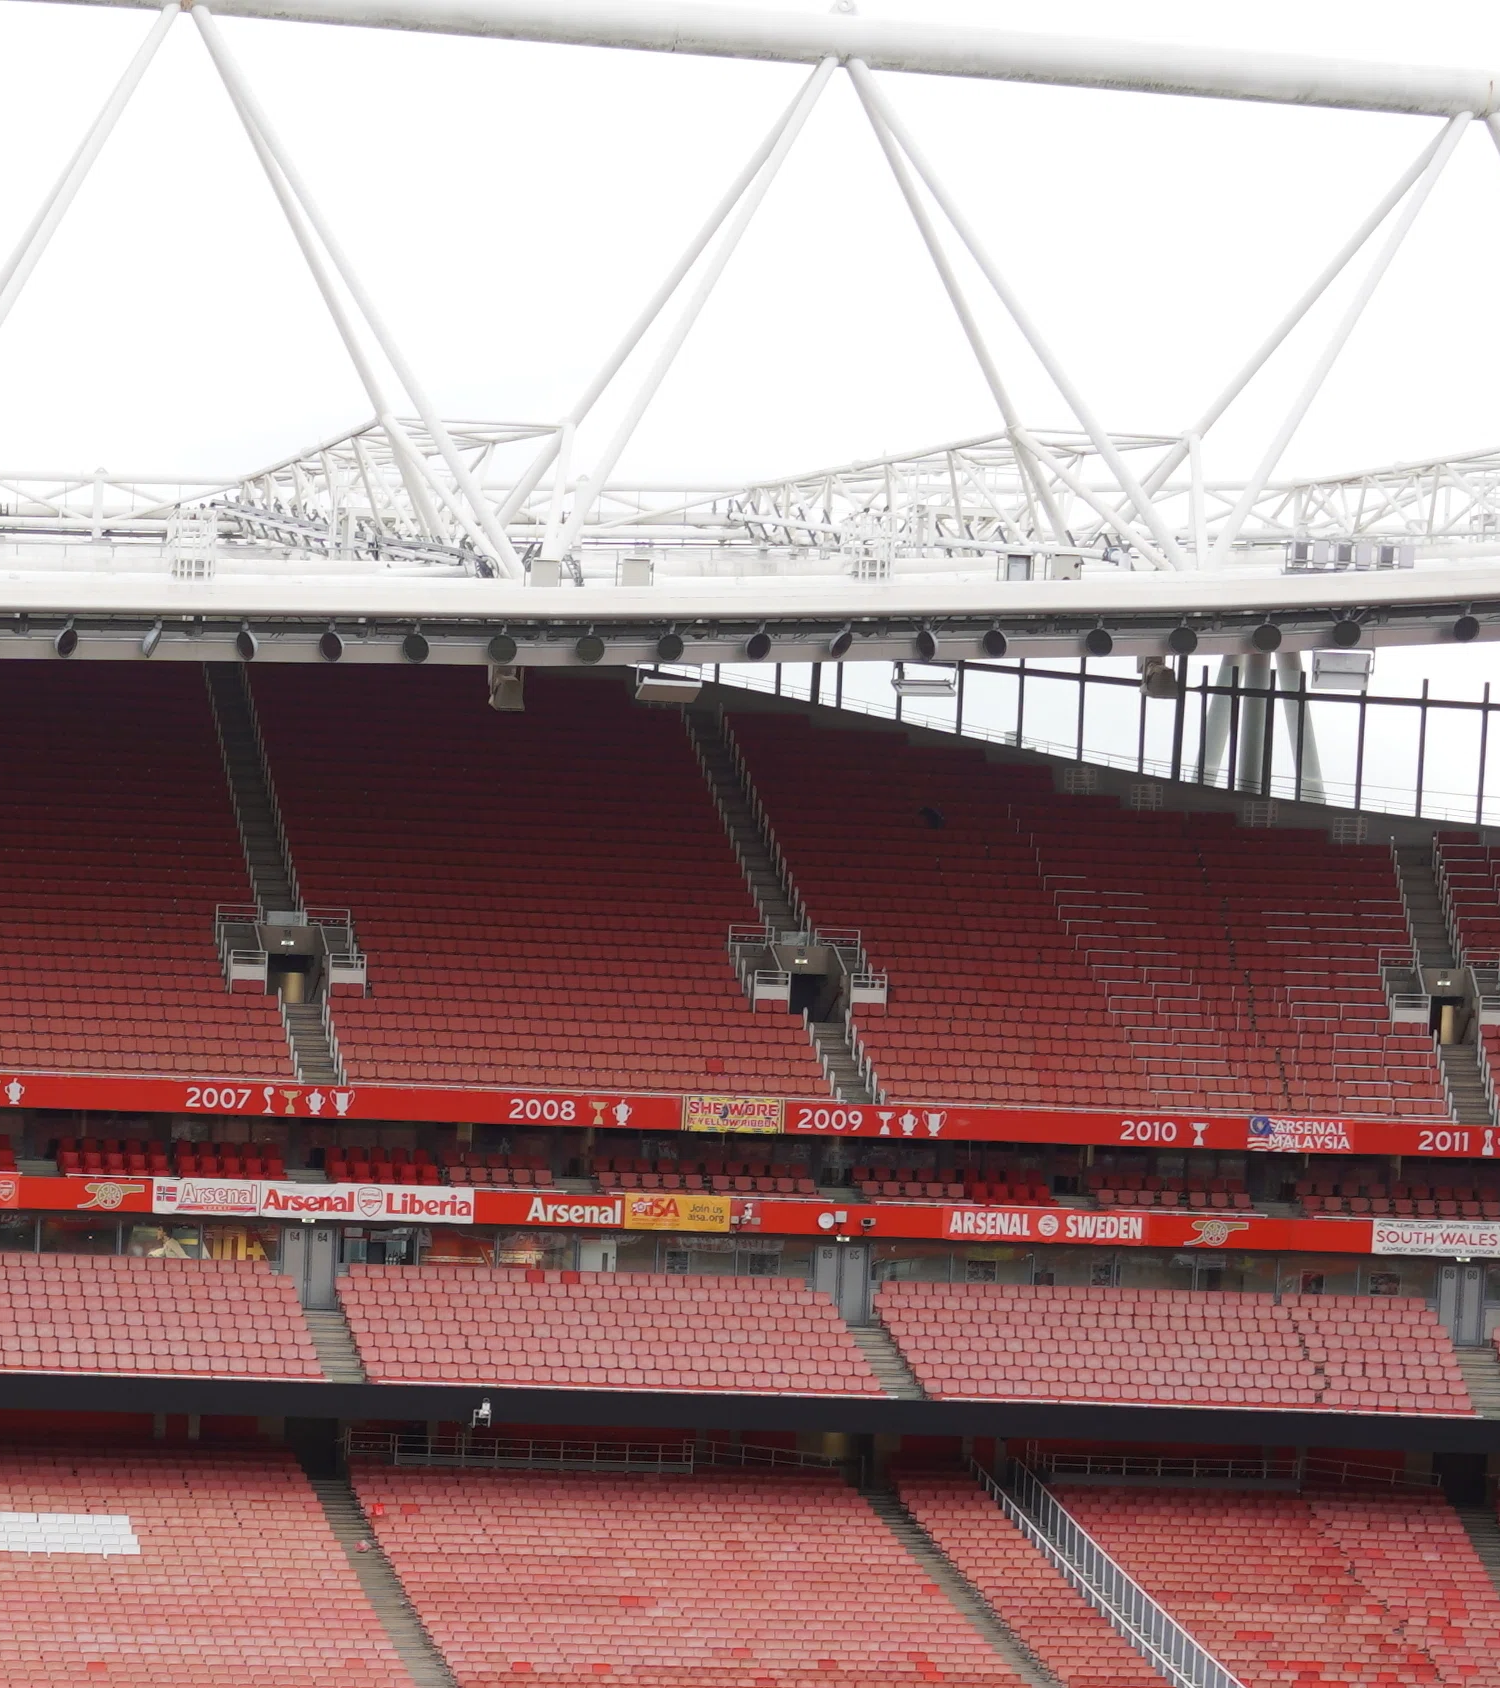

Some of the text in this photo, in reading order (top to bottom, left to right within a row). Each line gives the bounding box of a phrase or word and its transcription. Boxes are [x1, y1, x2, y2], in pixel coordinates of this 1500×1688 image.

[185, 1086, 252, 1110] 2007
[508, 1098, 577, 1122] 2008
[688, 1101, 779, 1117] SHE WORE
[697, 1118, 738, 1128] YELLOW
[797, 1108, 864, 1132] 2009
[1273, 1120, 1347, 1136] ARSENAL
[1119, 1119, 1178, 1142] 2010
[1267, 1133, 1351, 1151] MALAYSIA
[1417, 1129, 1470, 1153] 2011
[181, 1182, 258, 1205] Arsenal
[262, 1188, 472, 1217] Arsenal Liberia
[525, 1197, 622, 1225] Arsenal
[687, 1213, 725, 1224] aisa.org
[690, 1203, 724, 1214] Join us
[948, 1210, 1143, 1241] ARSENAL SWEDEN
[289, 1231, 300, 1242] 64
[317, 1232, 328, 1242] 64
[1376, 1230, 1435, 1245] SOUTH
[1440, 1232, 1498, 1246] WALES
